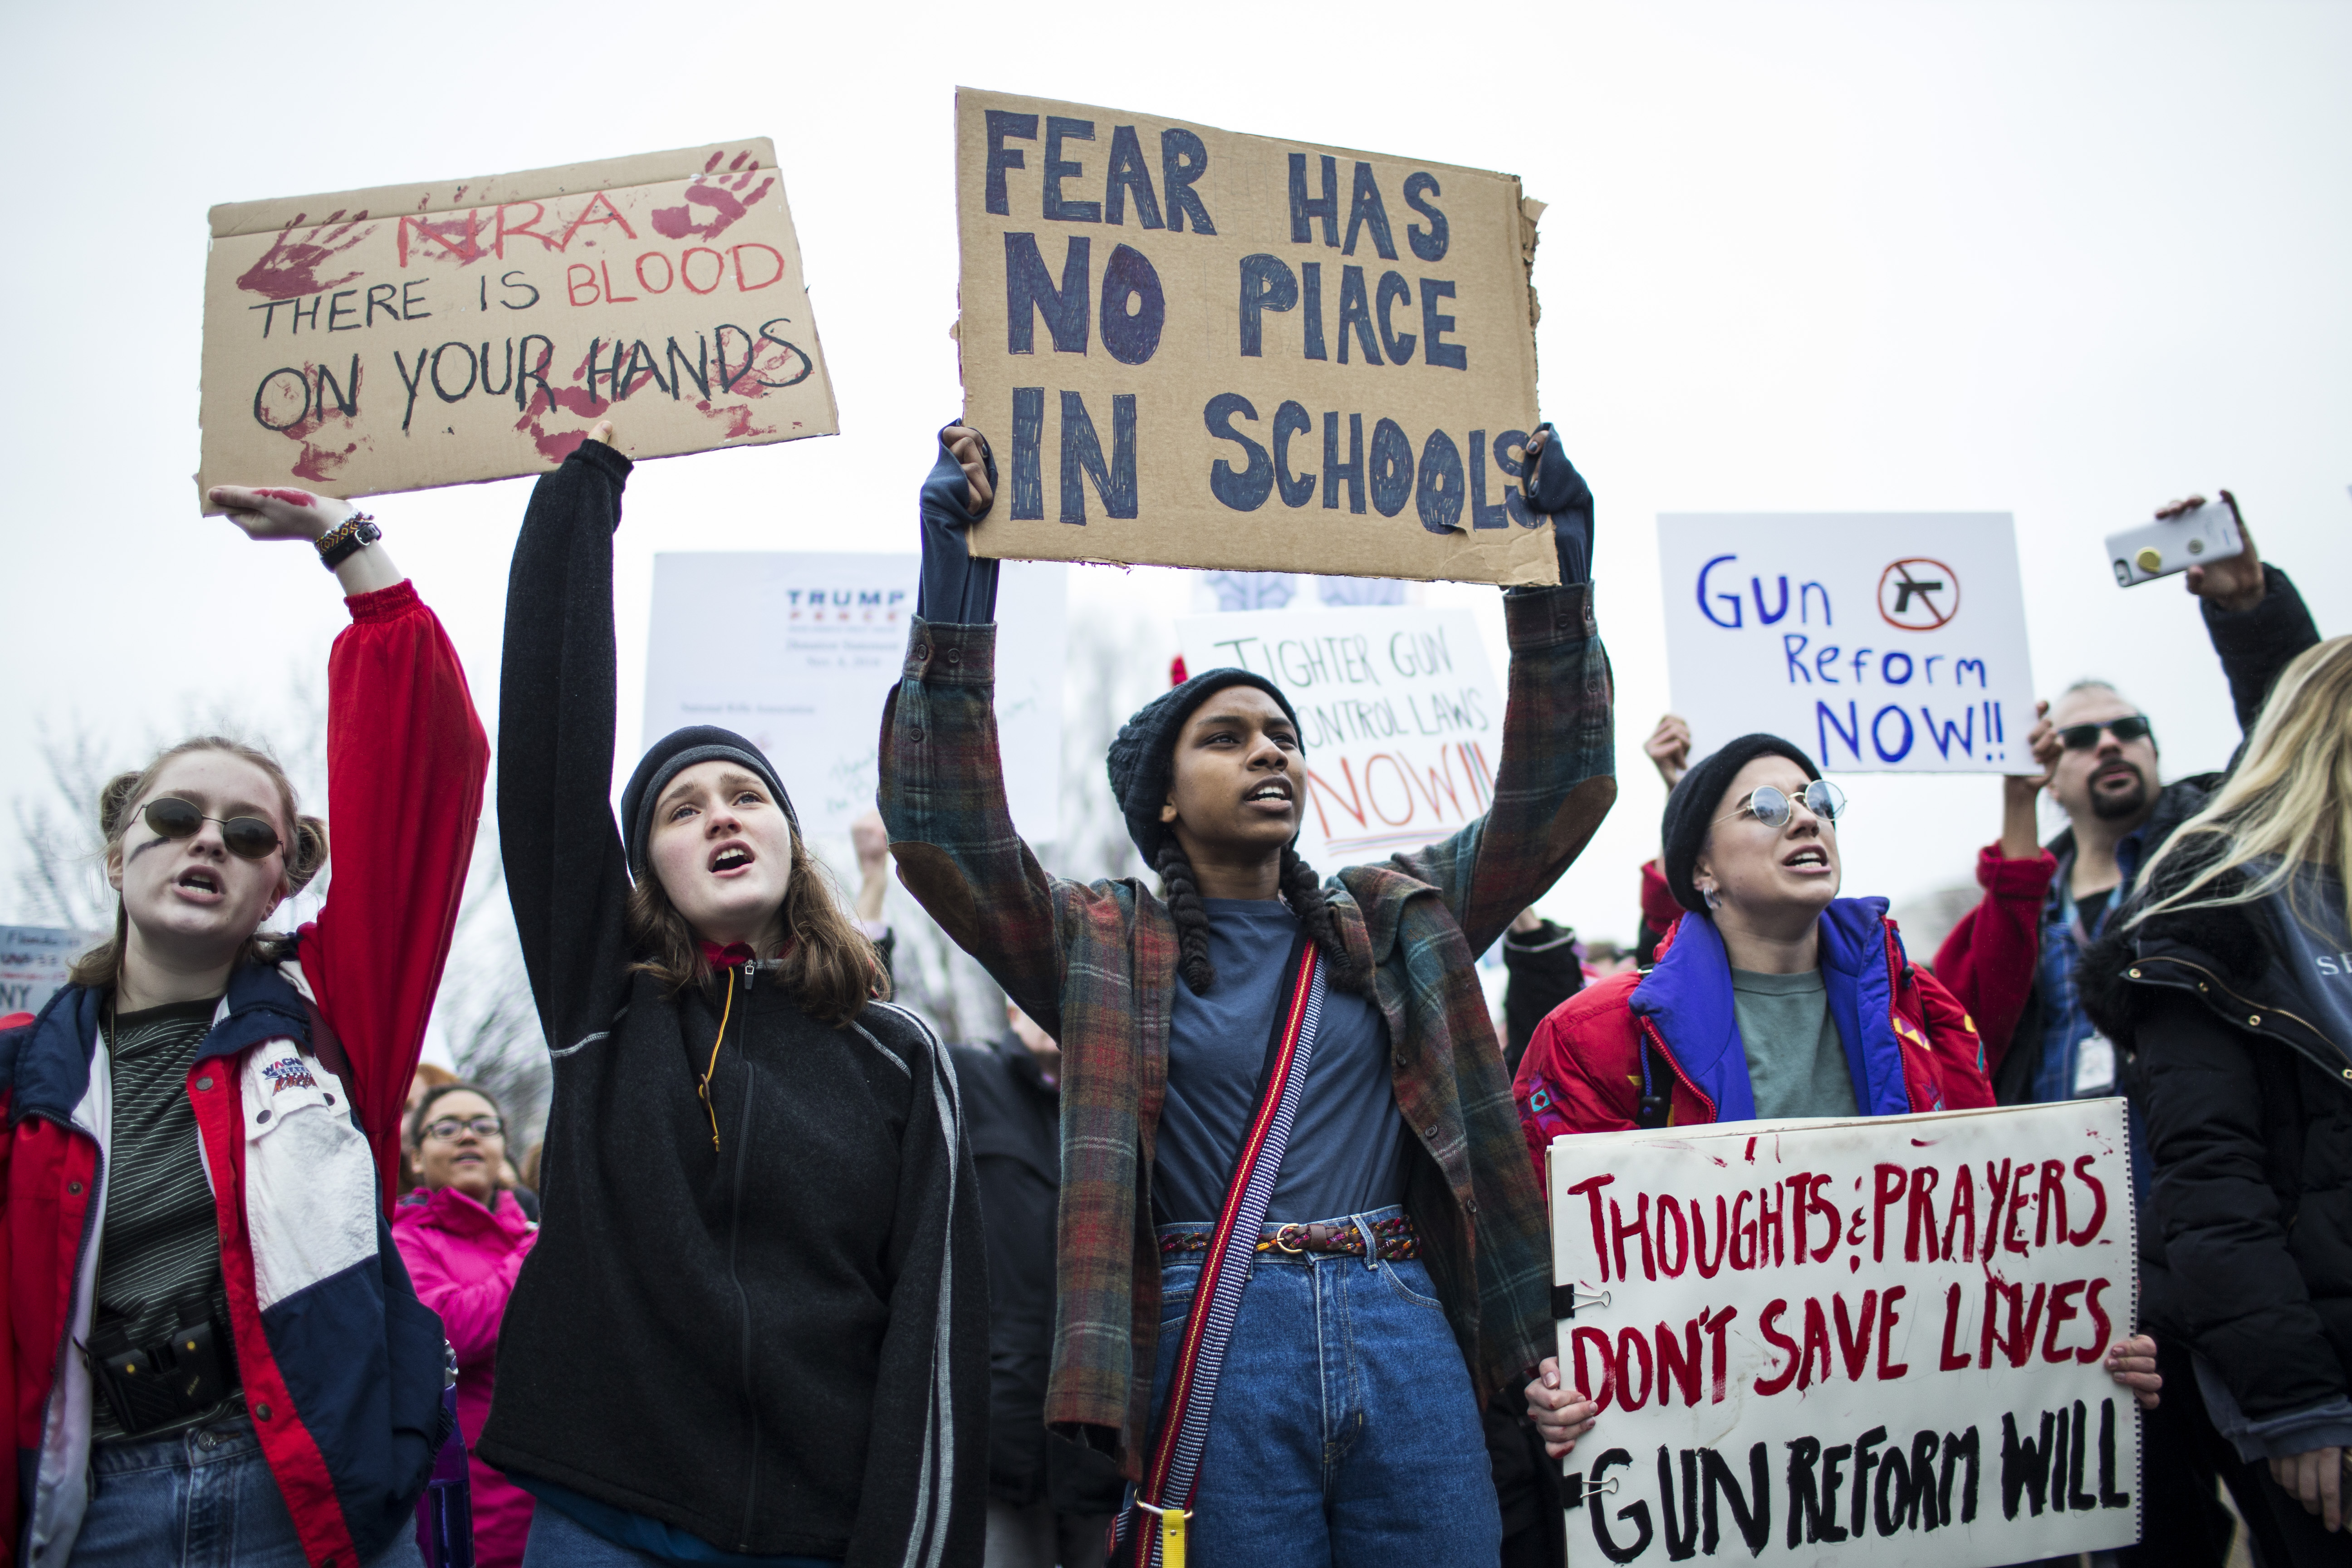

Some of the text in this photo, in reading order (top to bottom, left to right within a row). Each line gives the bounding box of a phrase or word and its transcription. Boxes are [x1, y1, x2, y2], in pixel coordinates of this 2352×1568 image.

[985, 109, 1450, 262] FEAR HAS
[397, 191, 637, 268] NRA
[249, 243, 785, 338] THERE IS BLOOD
[1004, 232, 1166, 365] NO
[254, 318, 813, 437] ON YOUR HANDS
[1010, 387, 1547, 534] IN SCHOOLS
[787, 589, 905, 607] TRUMP
[1696, 555, 1832, 629] Gun
[1214, 625, 1452, 687] TIGHTER GUN
[1783, 634, 1986, 688] Reform
[1296, 687, 1488, 748] ONTROL LAWS
[1816, 700, 2005, 767] NOW!!
[262, 1058, 304, 1076] WAGN
[1568, 1171, 1842, 1283] THOUGHTS
[1873, 1154, 2109, 1264] PRAYERS
[1571, 1277, 2111, 1416] DON'T SAVE LIVES
[1589, 1397, 2130, 1564] GUN REFORM WILL
